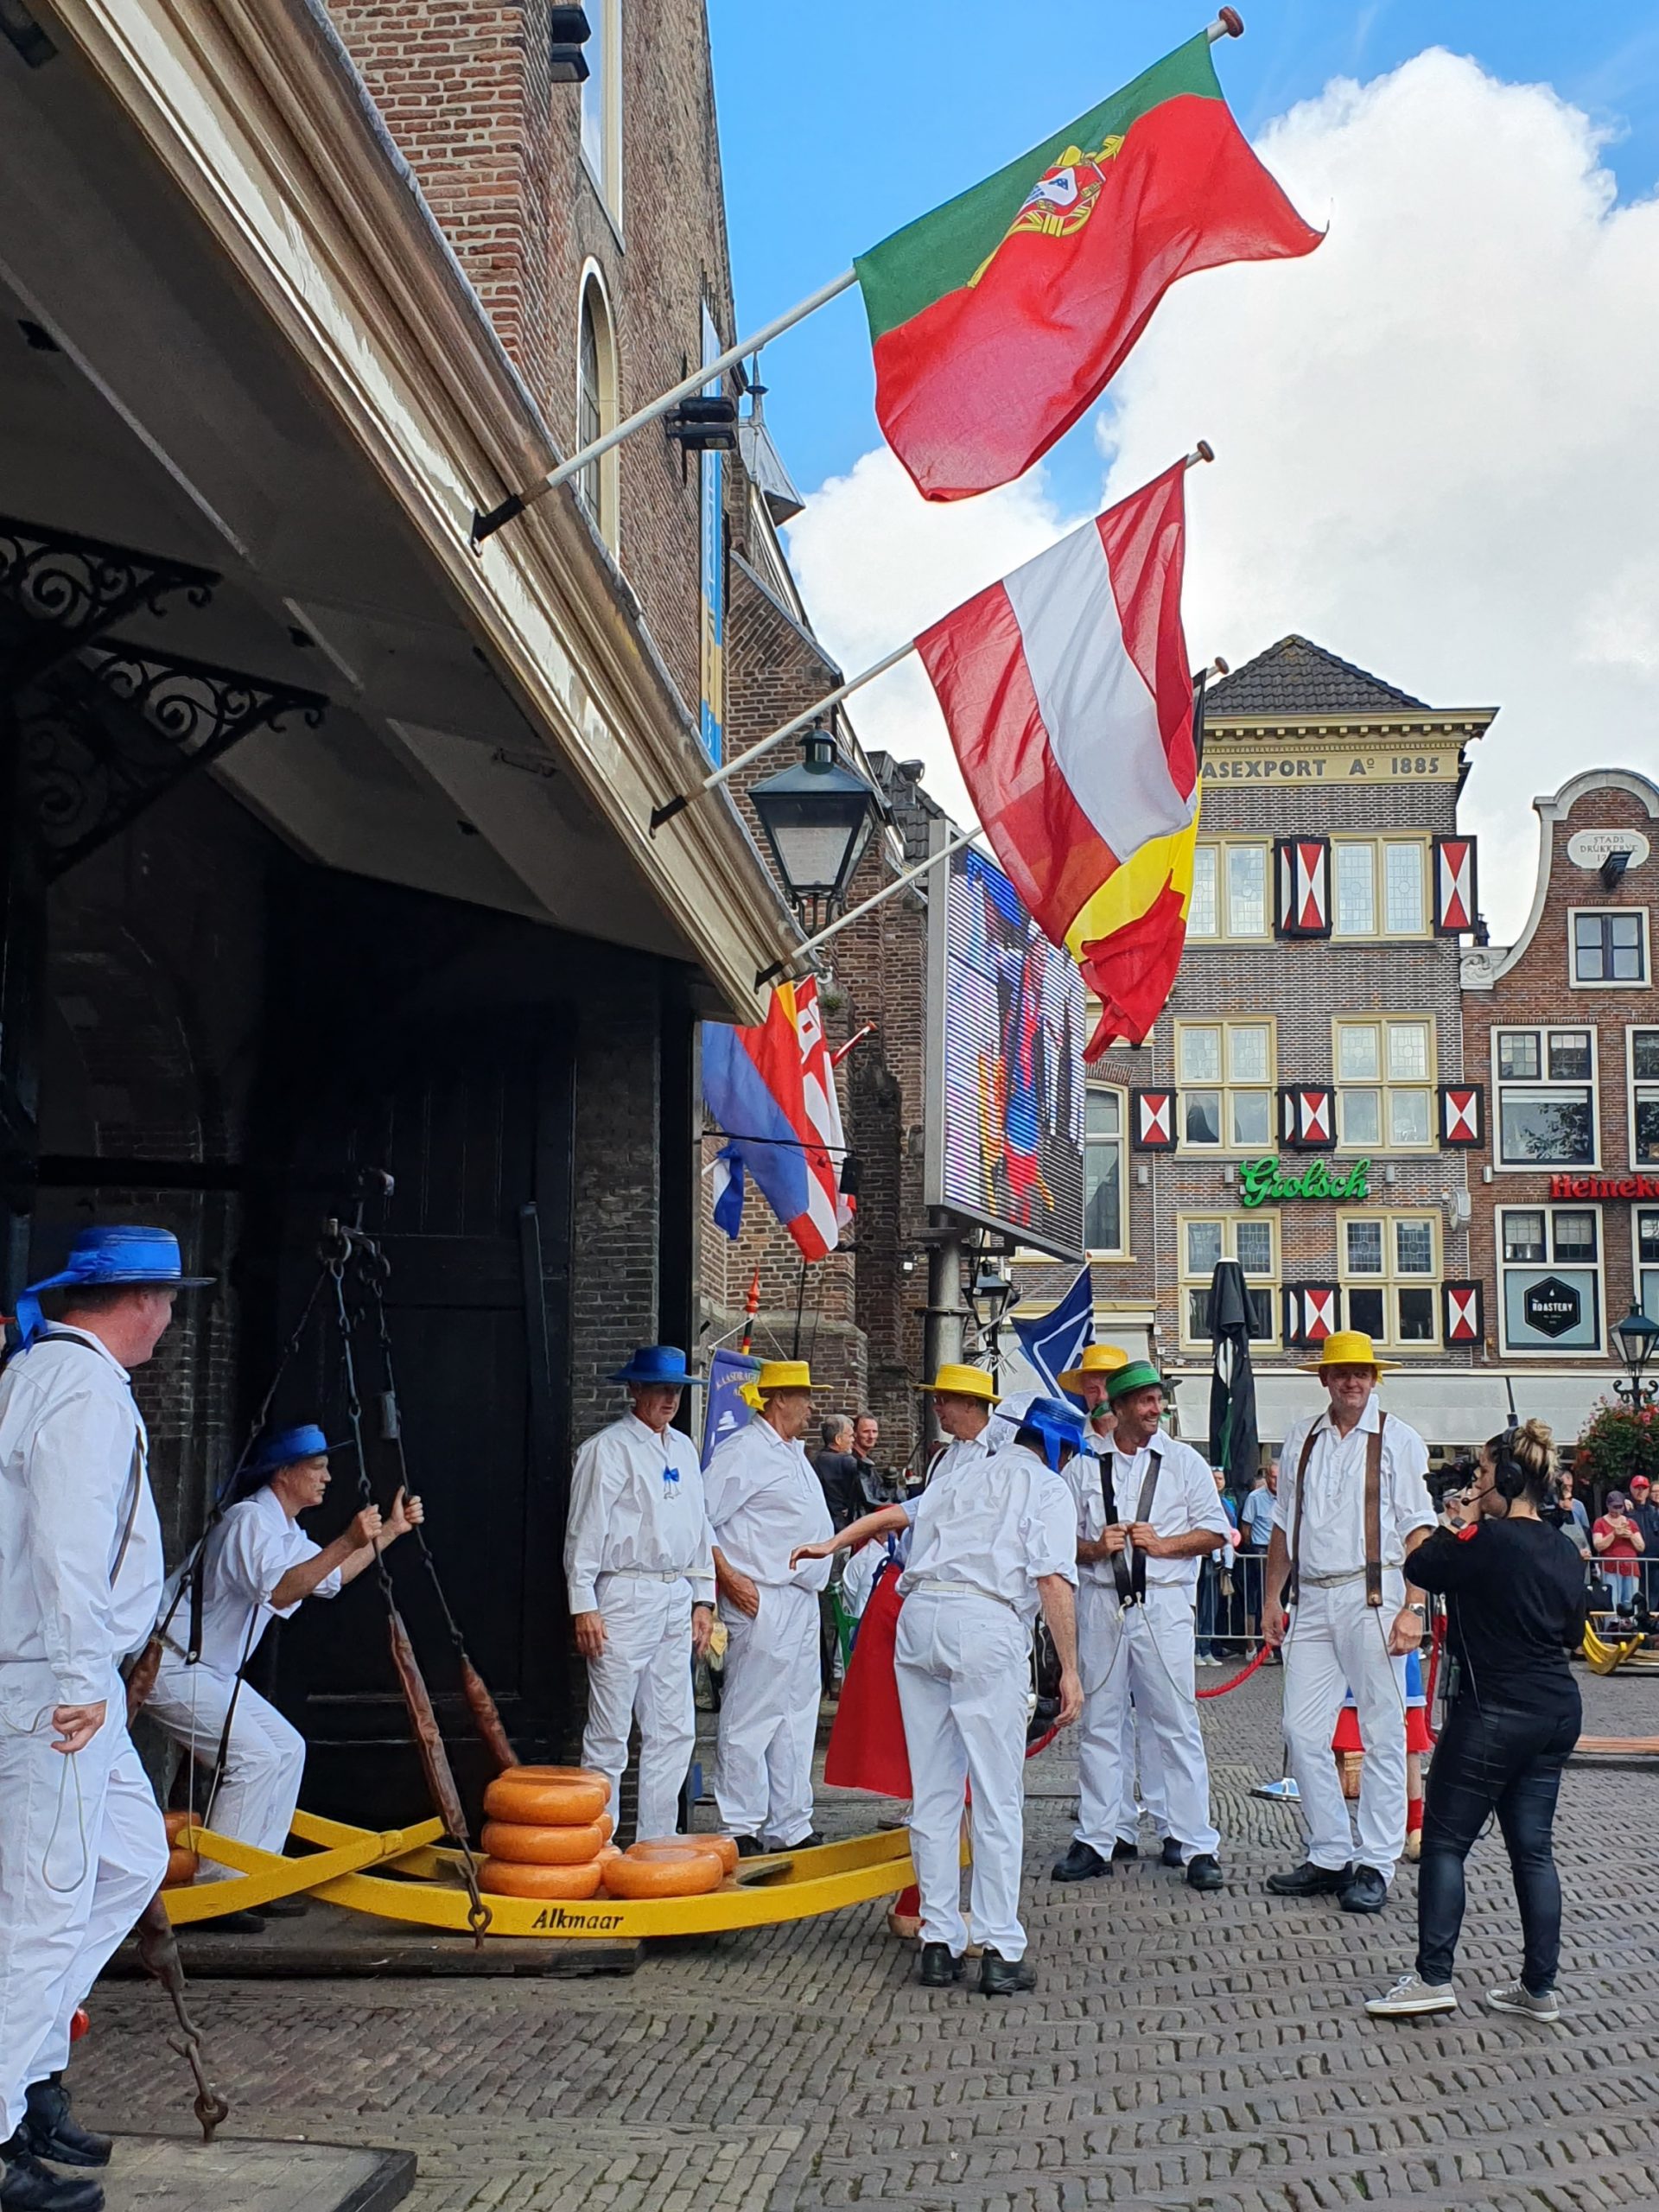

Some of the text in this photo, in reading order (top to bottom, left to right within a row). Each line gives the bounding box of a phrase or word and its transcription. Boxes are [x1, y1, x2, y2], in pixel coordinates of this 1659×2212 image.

[1201, 759, 1327, 778] ASEXPORT
[1391, 757, 1440, 775] 1885
[1593, 836, 1625, 845] STADS
[1240, 1155, 1371, 1207] Grolsch
[1551, 1174, 1659, 1198] Heinek
[1532, 1302, 1573, 1312] ROASTERY
[531, 1908, 625, 1929] Alkmaar
